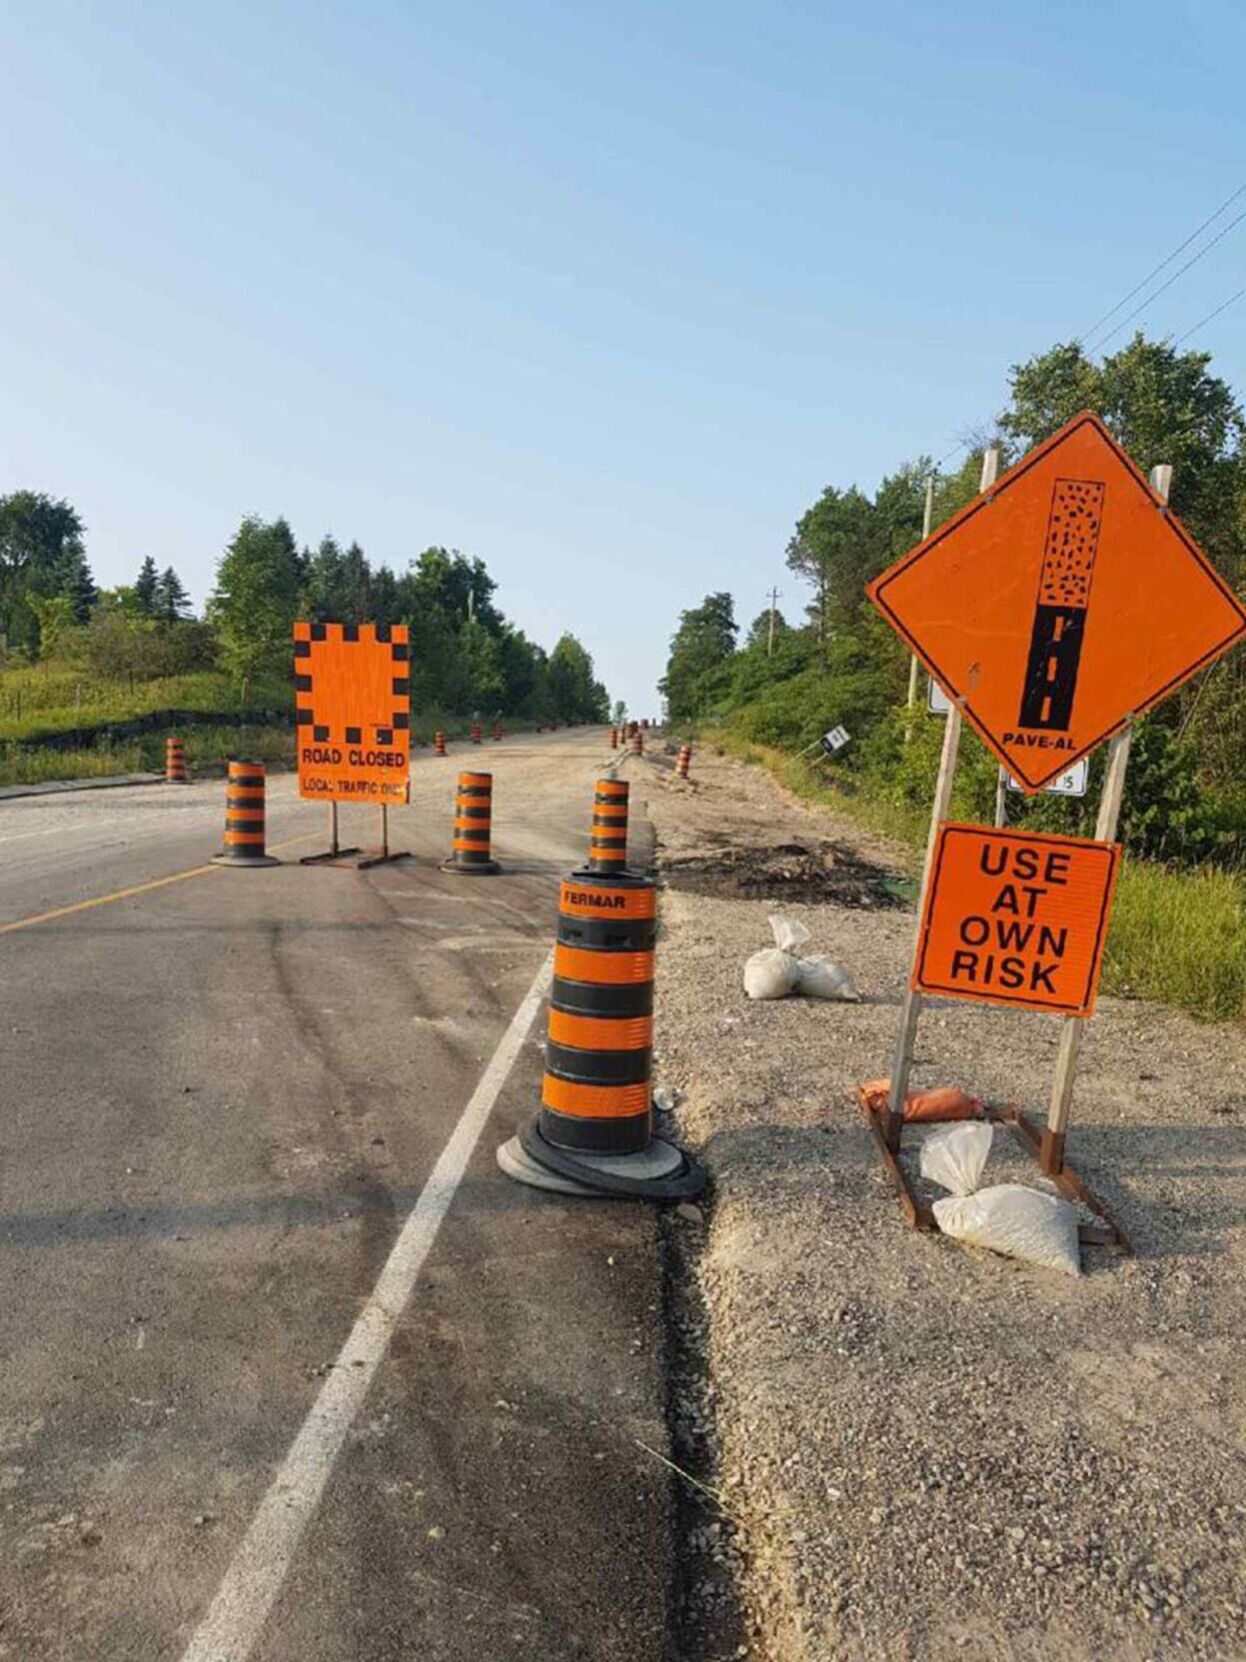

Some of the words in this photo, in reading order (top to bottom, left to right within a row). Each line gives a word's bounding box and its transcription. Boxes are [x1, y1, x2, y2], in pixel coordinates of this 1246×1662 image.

[1002, 733, 1076, 750] PAVE-AL
[302, 748, 342, 764] ROAD
[348, 750, 405, 768] CLOSED
[302, 777, 333, 793] LOCAL
[337, 780, 377, 795] TRAFFIC
[980, 844, 1071, 885] USE
[564, 891, 626, 909] FERMAR
[991, 884, 1047, 918] AT
[959, 916, 1068, 958] OWN
[951, 949, 1060, 994] RISK
